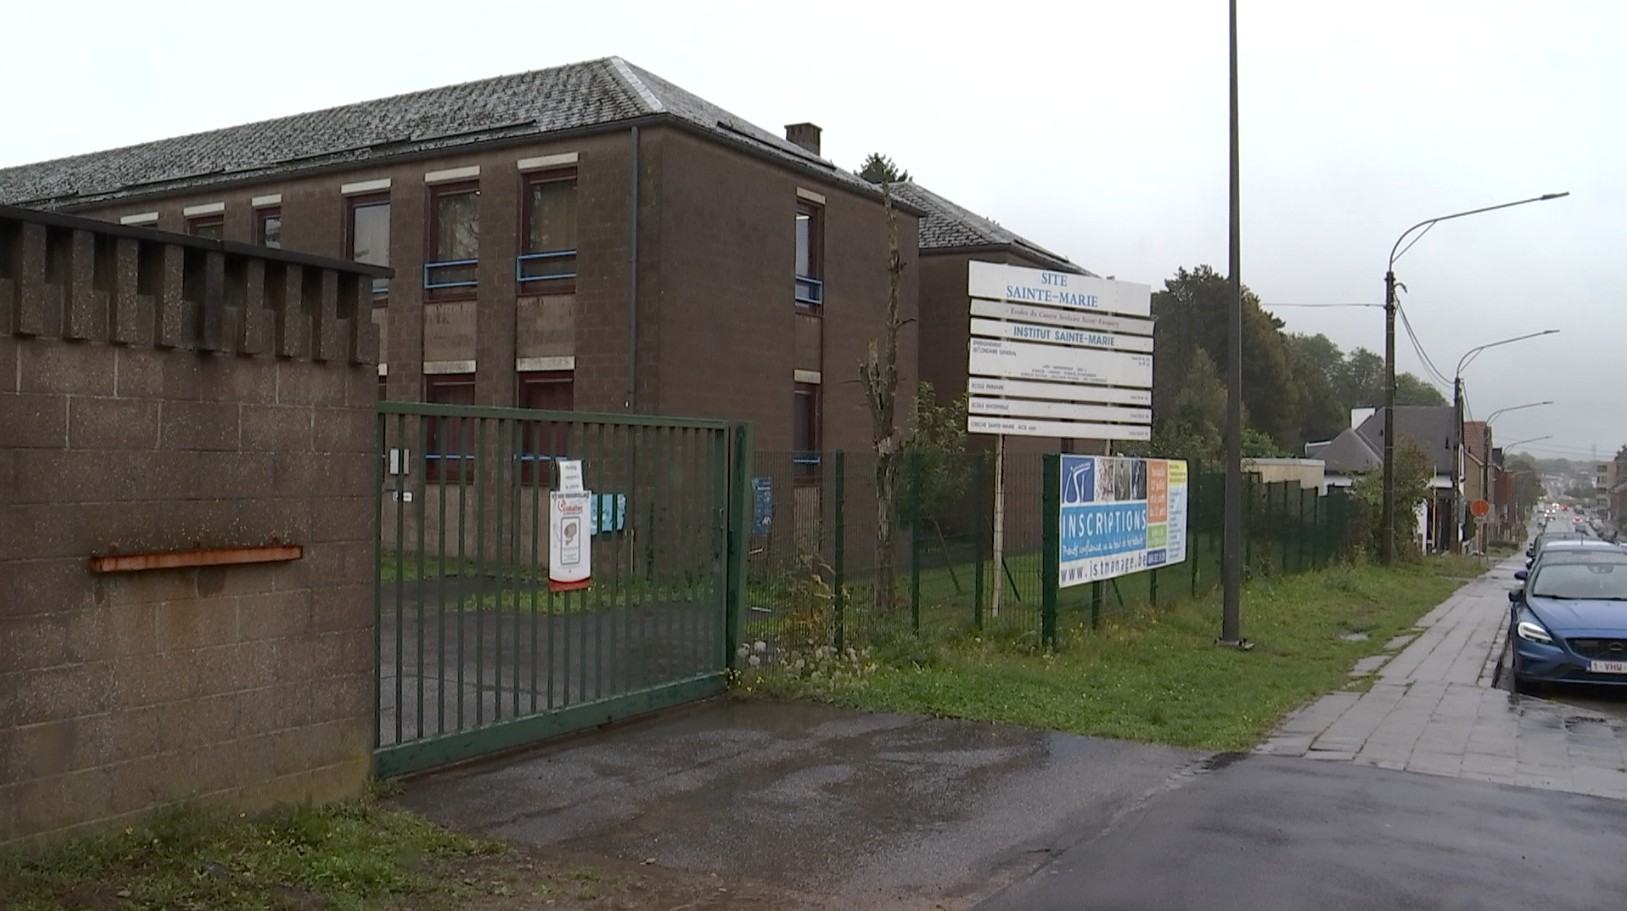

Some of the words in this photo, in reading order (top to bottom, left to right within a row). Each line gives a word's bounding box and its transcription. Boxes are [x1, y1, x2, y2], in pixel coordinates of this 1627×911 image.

[1041, 272, 1068, 287] SITE
[1006, 285, 1098, 308] SAINTE-MARIE
[1013, 325, 1051, 340] INSTITUT
[1054, 329, 1115, 346] SAINTE-MARIE
[1062, 509, 1146, 539] INSCRIPTIONS
